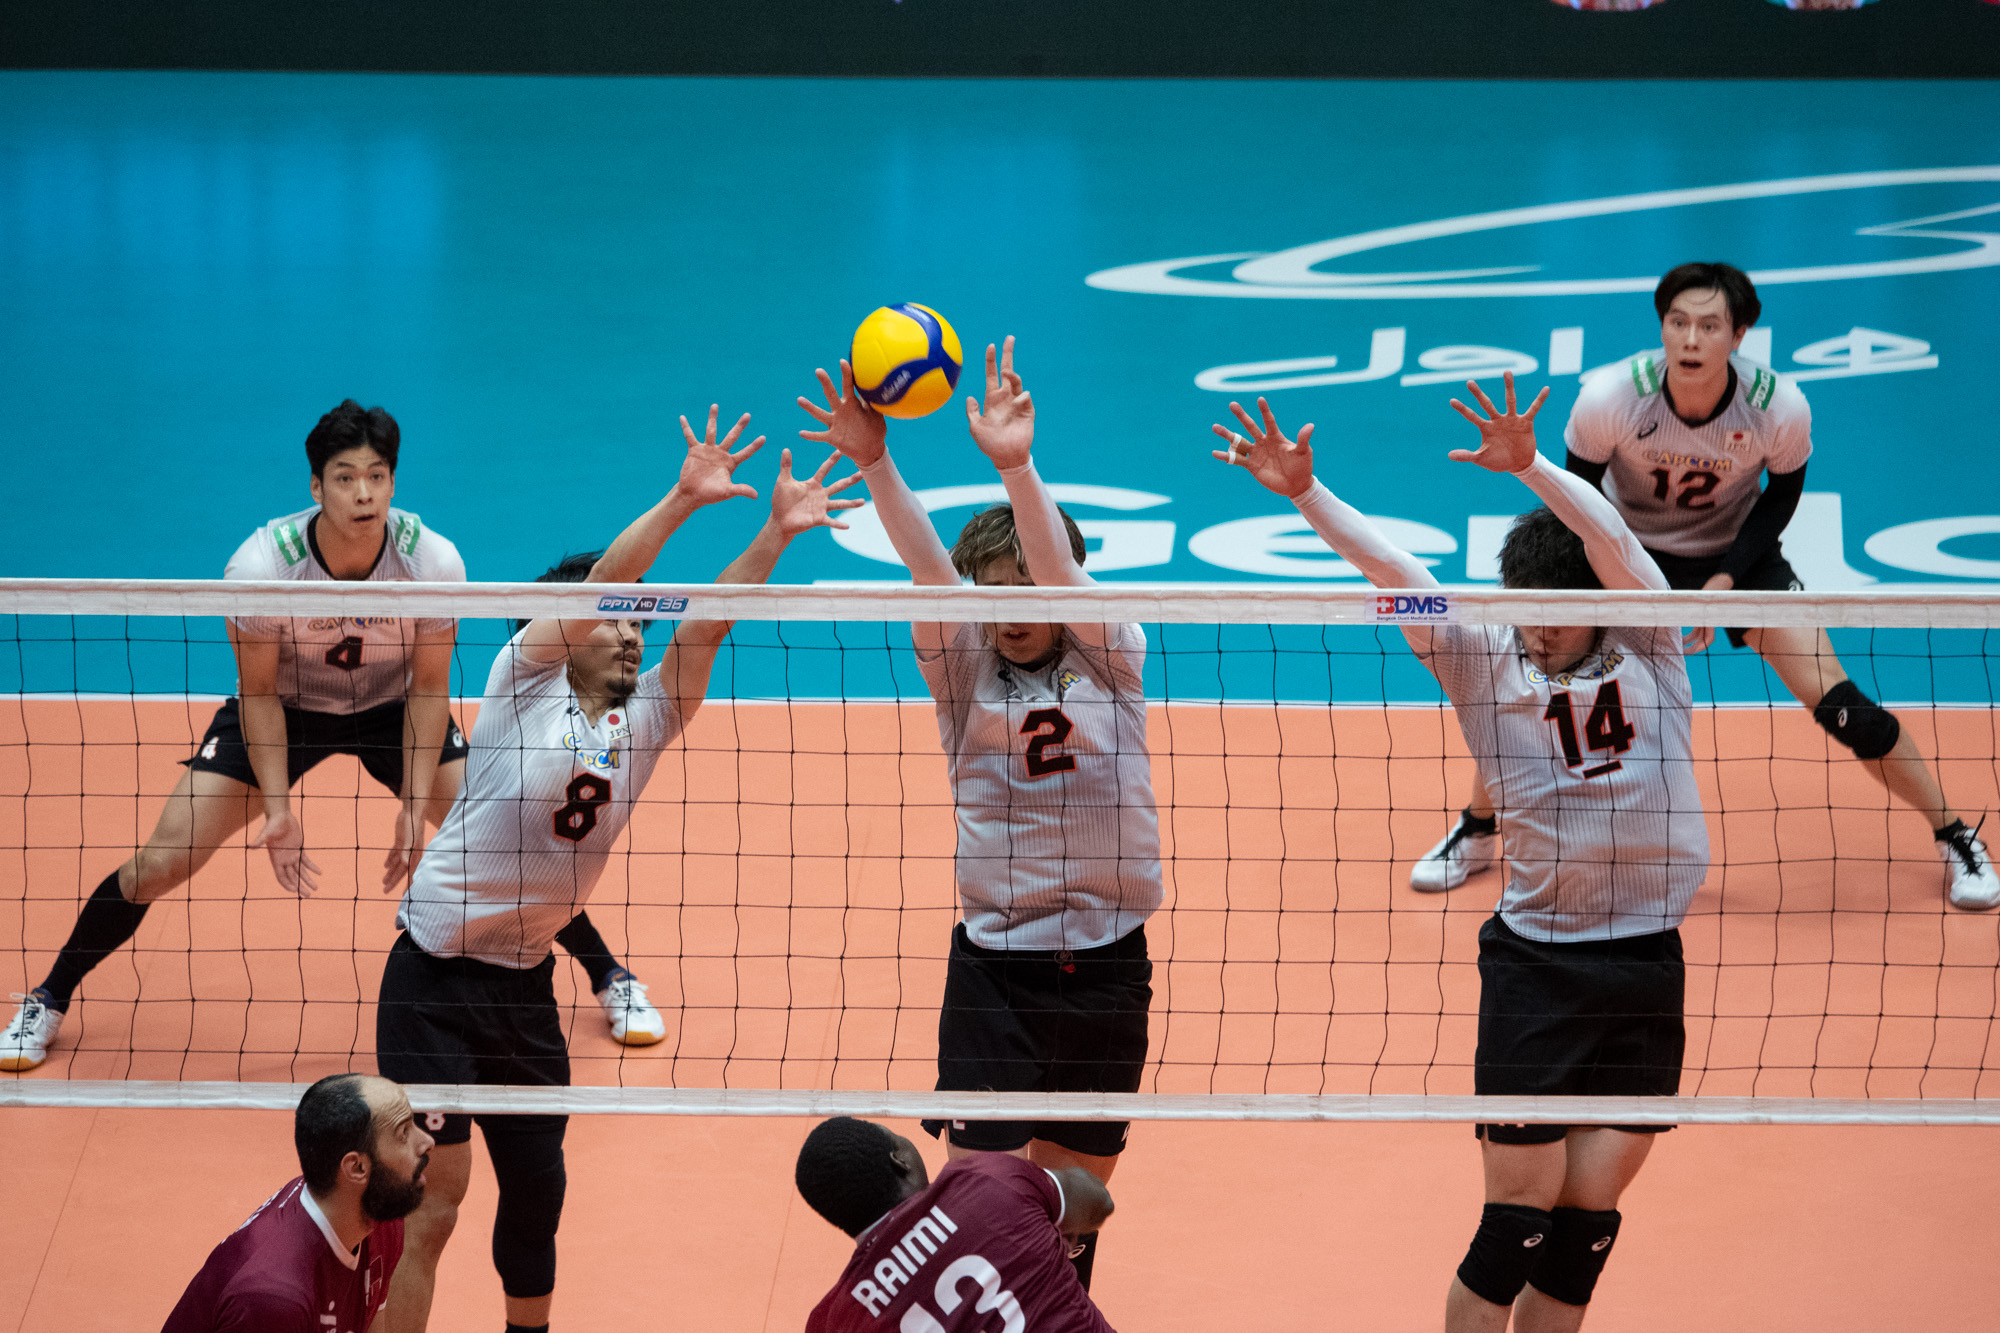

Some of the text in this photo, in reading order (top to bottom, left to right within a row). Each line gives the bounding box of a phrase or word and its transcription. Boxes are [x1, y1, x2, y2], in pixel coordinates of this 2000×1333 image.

[1642, 449, 1732, 472] CAPCOM
[1650, 467, 1721, 510] 12
[600, 598, 684, 611] PPTV HD 36
[1376, 596, 1448, 614] BDMS
[325, 635, 366, 672] 4
[609, 726, 629, 739] JPN
[1018, 707, 1078, 777] 2
[1543, 678, 1636, 770] 14
[201, 736, 219, 760] 4
[552, 772, 612, 842] 8
[850, 1205, 958, 1319] RAIMI
